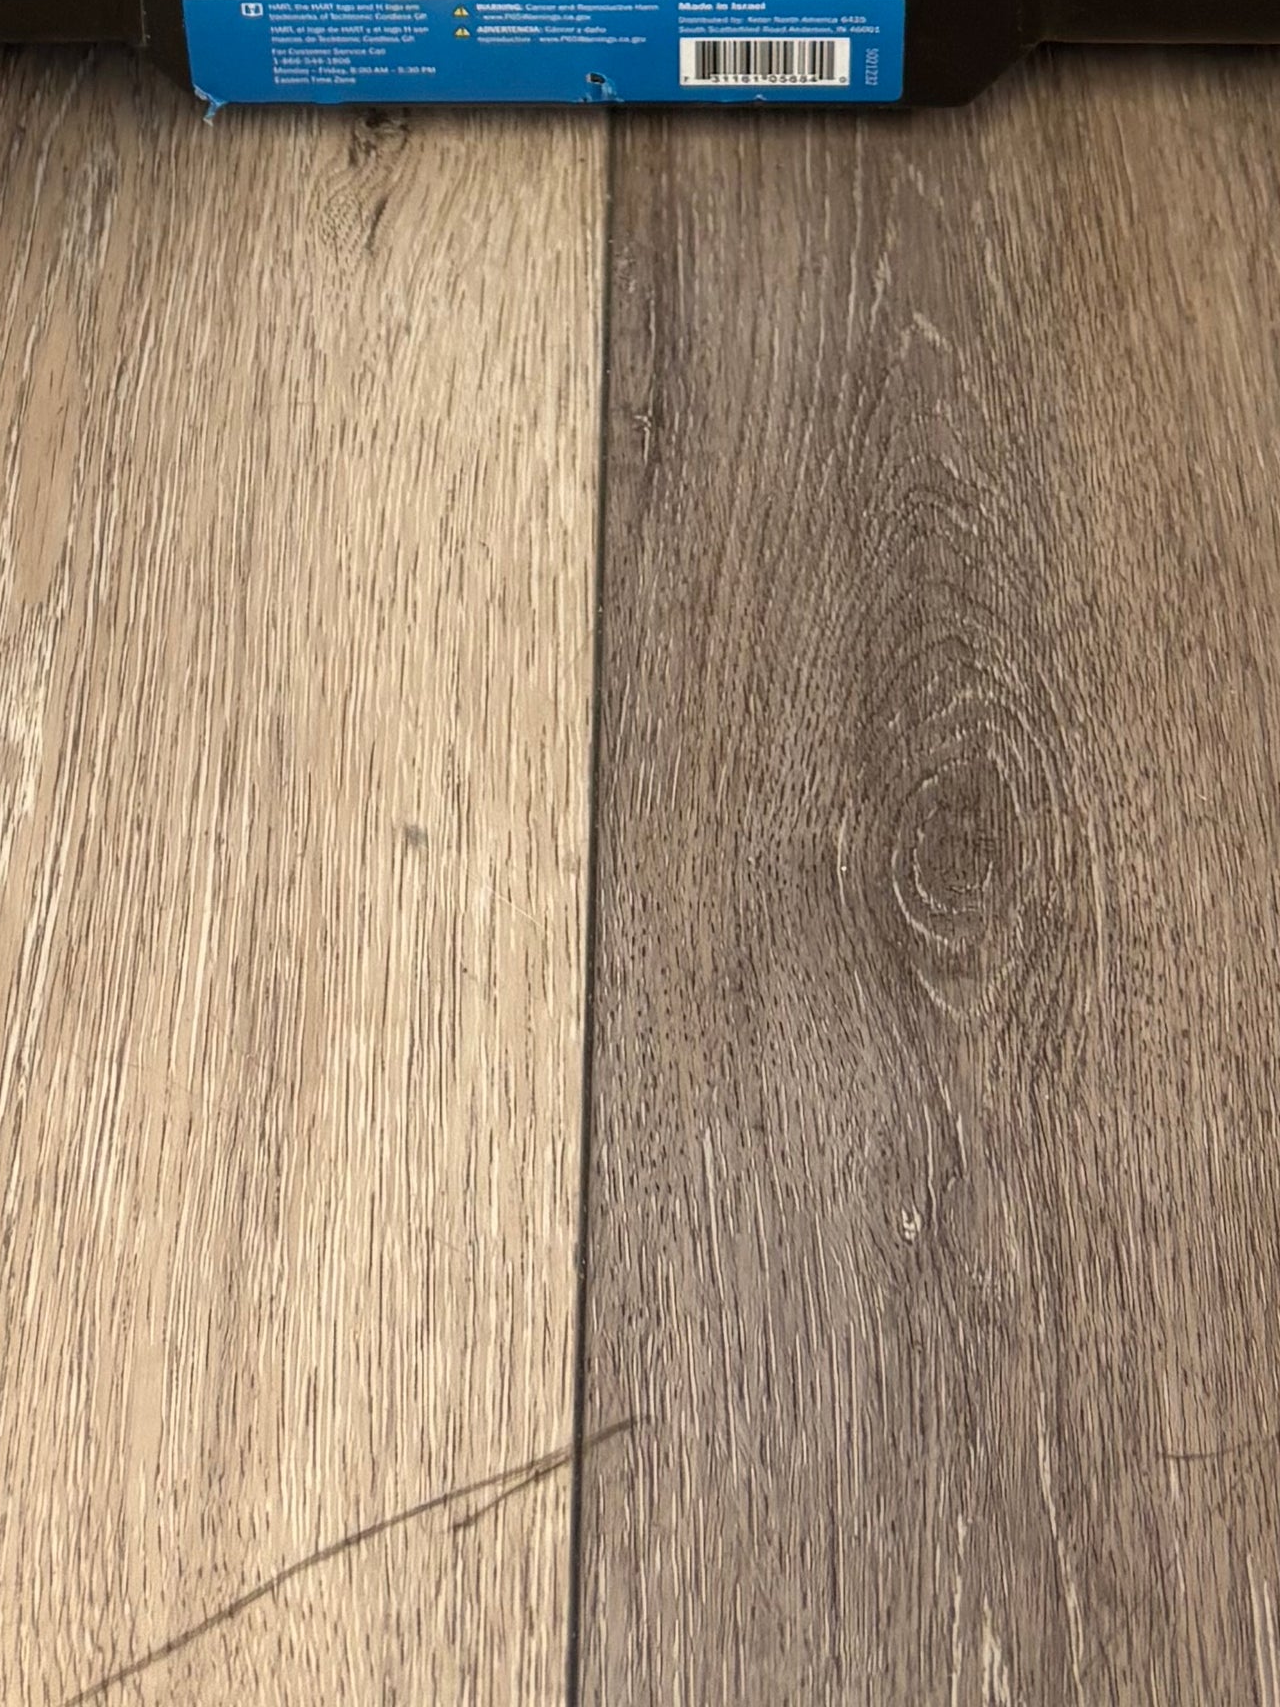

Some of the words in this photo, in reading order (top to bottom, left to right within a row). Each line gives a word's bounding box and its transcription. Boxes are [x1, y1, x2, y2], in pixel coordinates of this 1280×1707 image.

[678, 2, 713, 11] Made
[715, 2, 728, 10] in
[731, 2, 766, 10] Israel
